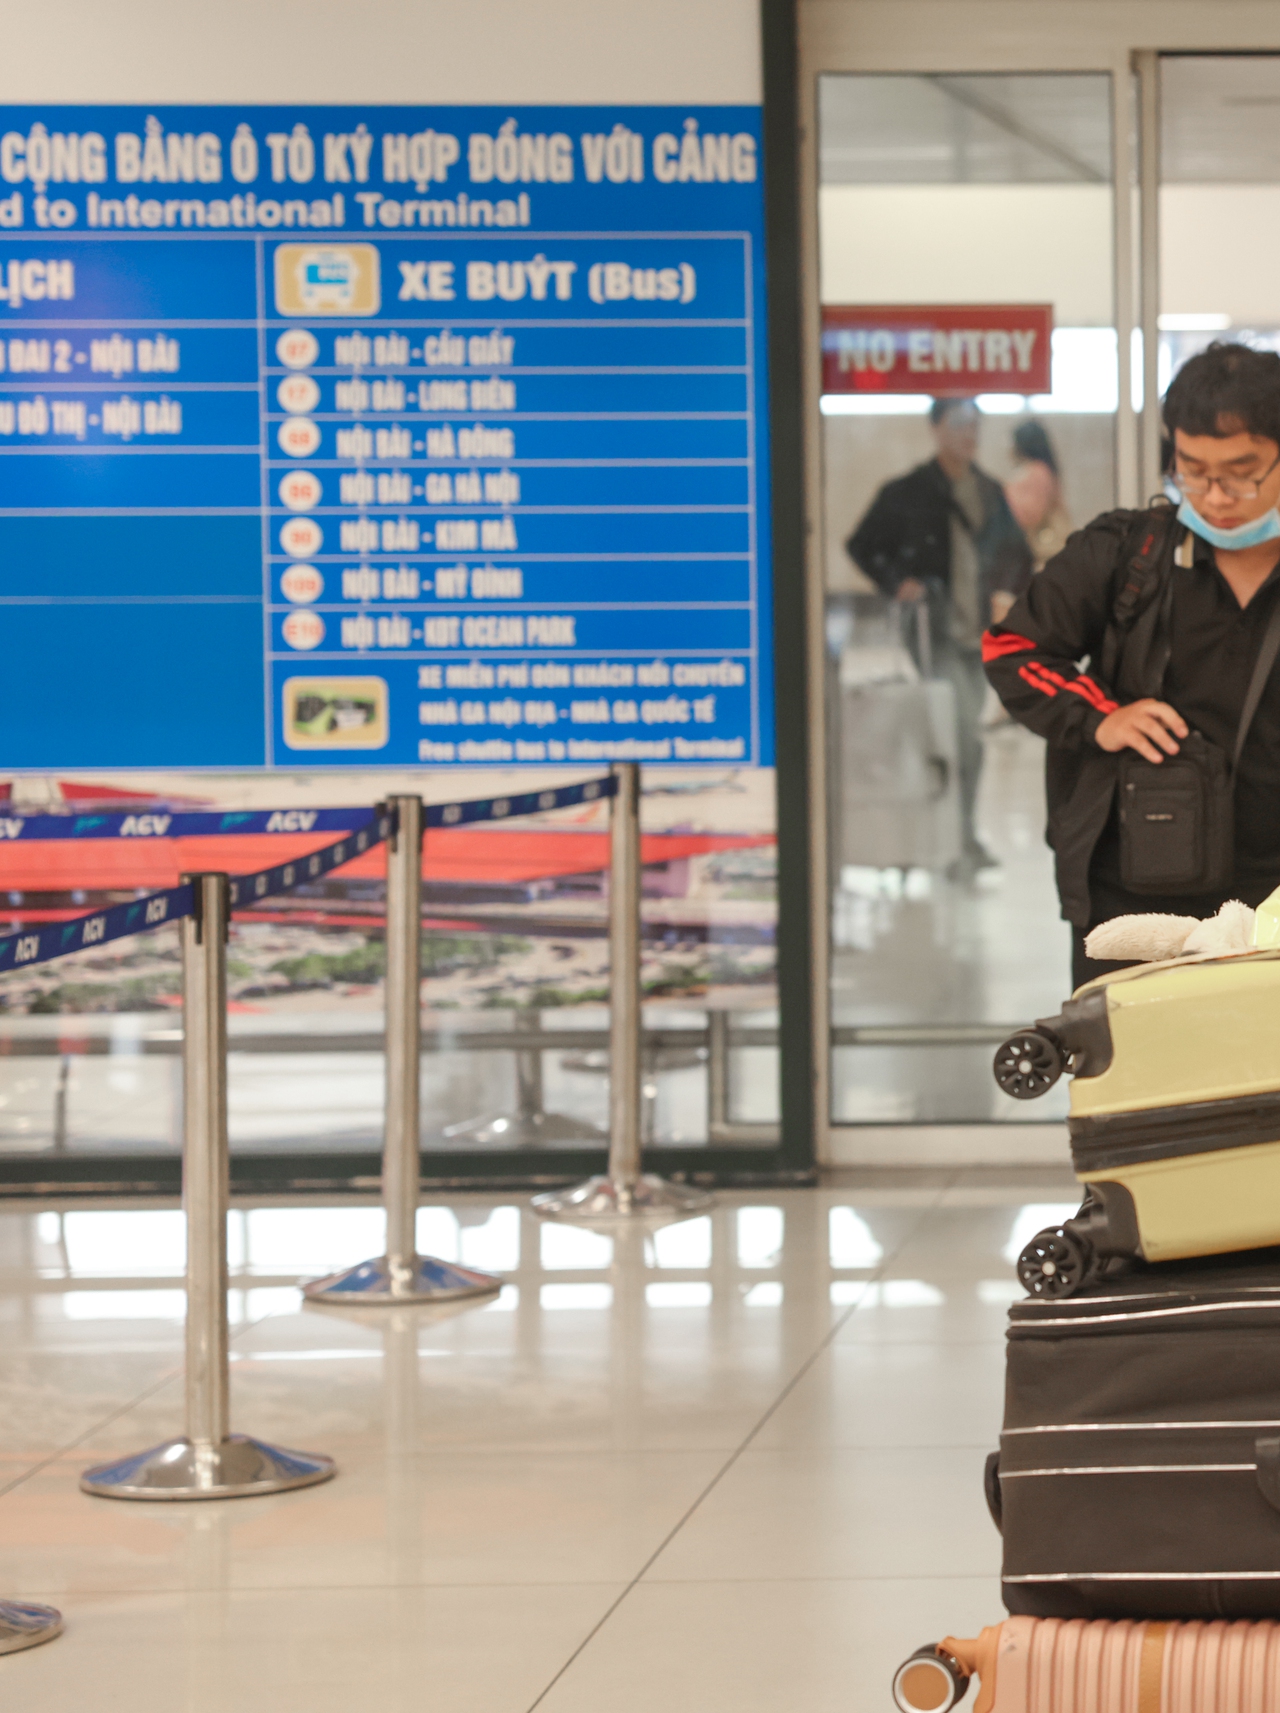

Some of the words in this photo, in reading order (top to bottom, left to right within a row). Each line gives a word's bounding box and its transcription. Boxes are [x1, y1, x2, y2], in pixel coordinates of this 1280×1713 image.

[115, 114, 222, 184] BẰNG
[230, 123, 259, 184] Ô
[265, 123, 315, 184] TÔ
[323, 123, 374, 184] KÝ
[382, 128, 460, 193] HỢP
[581, 123, 645, 184] VỚI
[653, 117, 757, 184] CẢNG
[33, 194, 78, 228] to
[87, 191, 346, 228] International
[355, 191, 531, 228] Terminal
[398, 261, 455, 301] XE
[466, 253, 577, 301] BUÝT
[587, 262, 697, 304] (Bus)
[54, 339, 72, 374] 2
[838, 328, 896, 374] NO
[907, 329, 1037, 373] ENTRY
